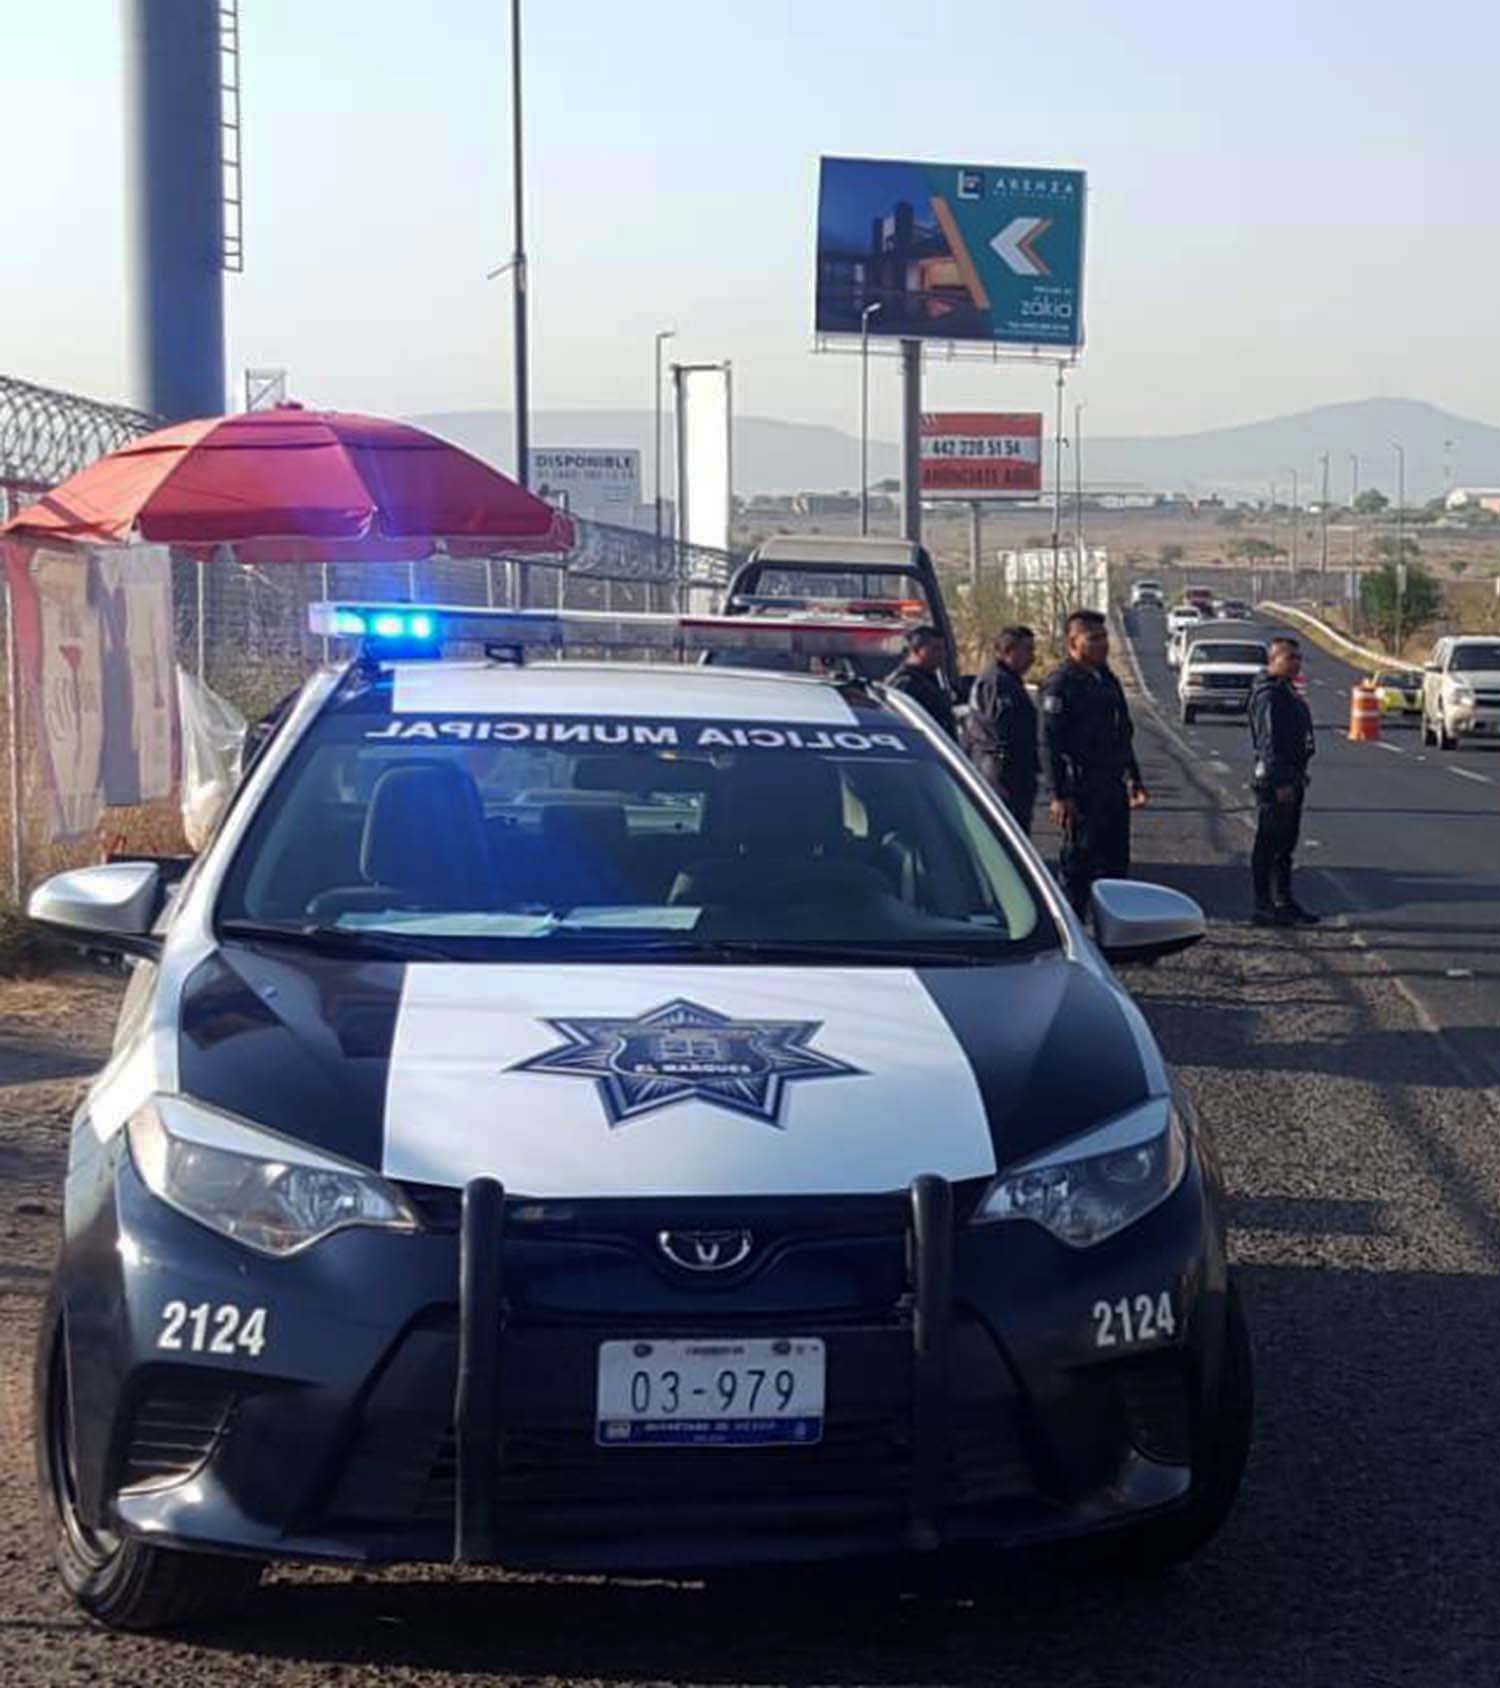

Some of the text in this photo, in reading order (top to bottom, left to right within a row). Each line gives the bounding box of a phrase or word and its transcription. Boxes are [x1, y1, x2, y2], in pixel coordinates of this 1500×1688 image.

[535, 455, 631, 469] DISPONIBLE
[634, 1064, 751, 1074] EL MARQUES
[157, 1300, 267, 1356] 2124
[1093, 1292, 1176, 1347] 2124
[630, 1369, 795, 1413] 03-979
